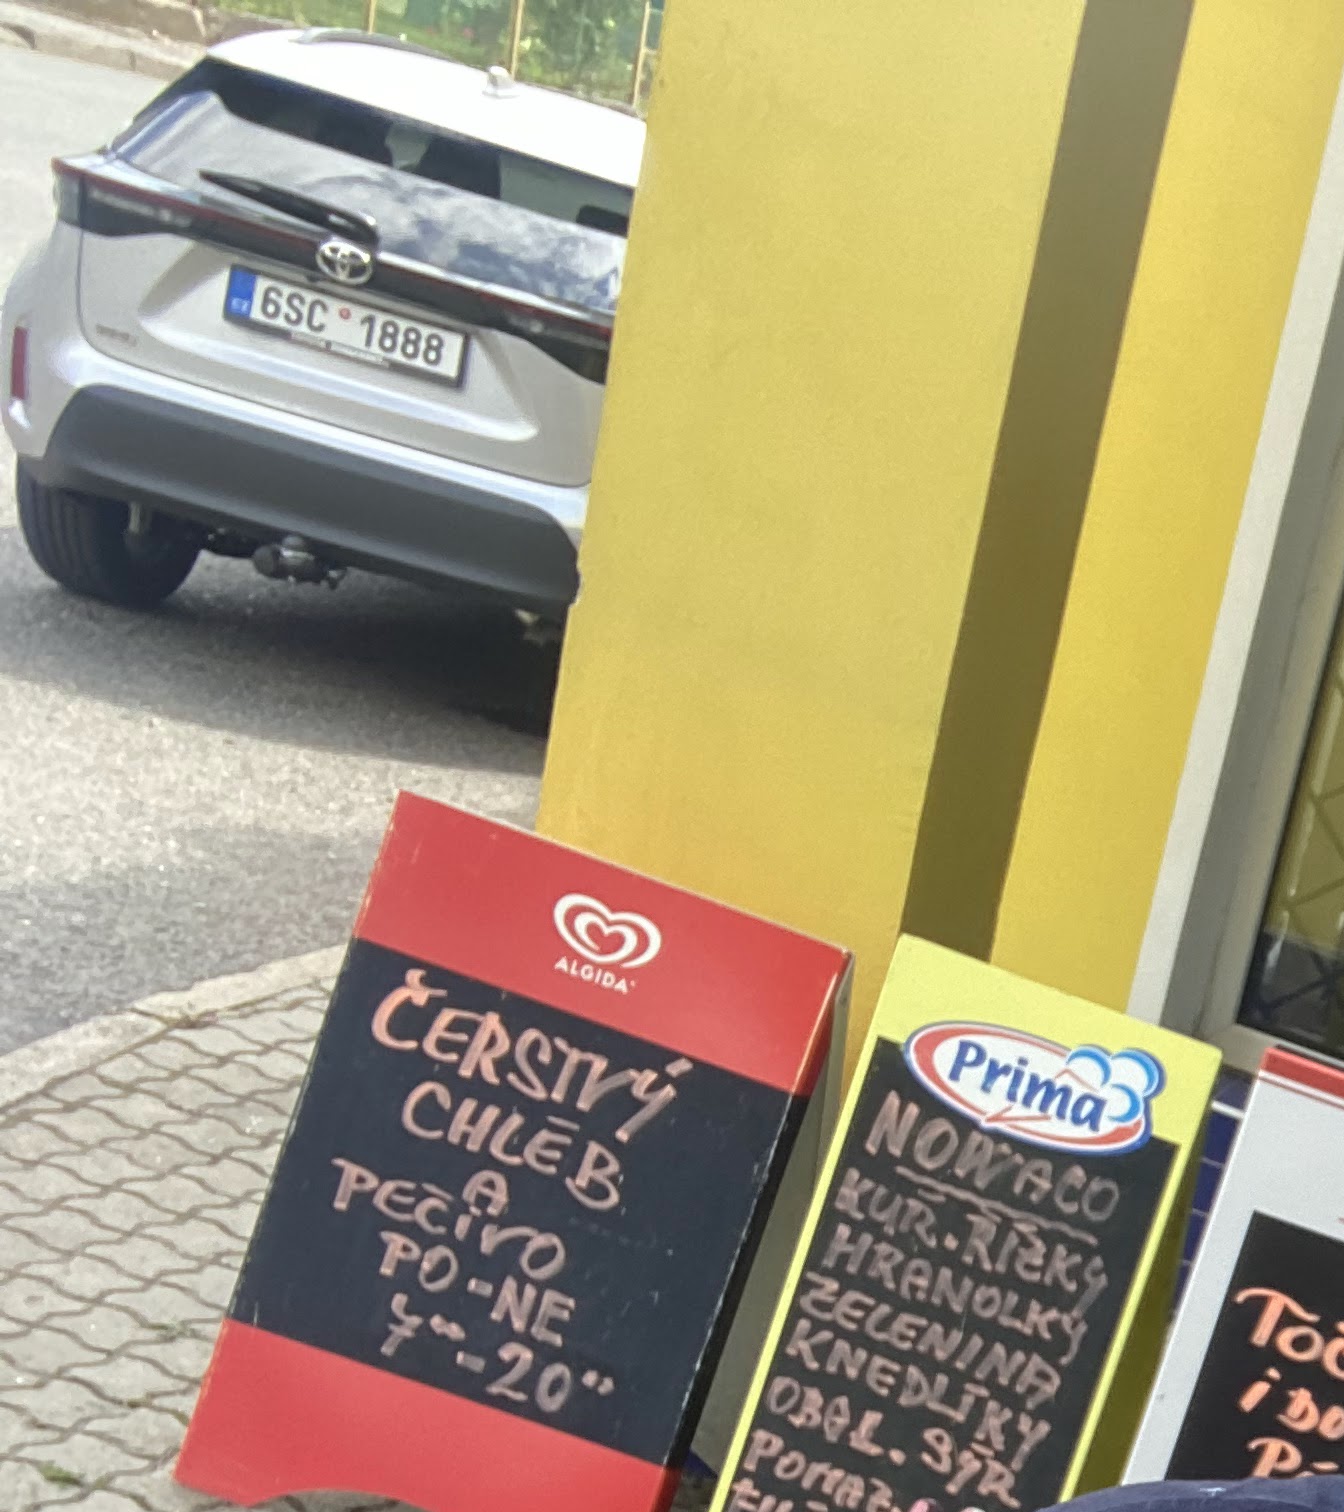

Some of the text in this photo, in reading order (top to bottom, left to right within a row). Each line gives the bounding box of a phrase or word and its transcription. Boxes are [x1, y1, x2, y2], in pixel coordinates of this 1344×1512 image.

[261, 286, 328, 333] 6SC
[360, 314, 444, 366] 1888
[554, 955, 629, 995] ALGIDA
[952, 1040, 1106, 1132] Prima
[463, 1170, 509, 1217] A
[823, 1223, 1087, 1366] HRANOLKY
